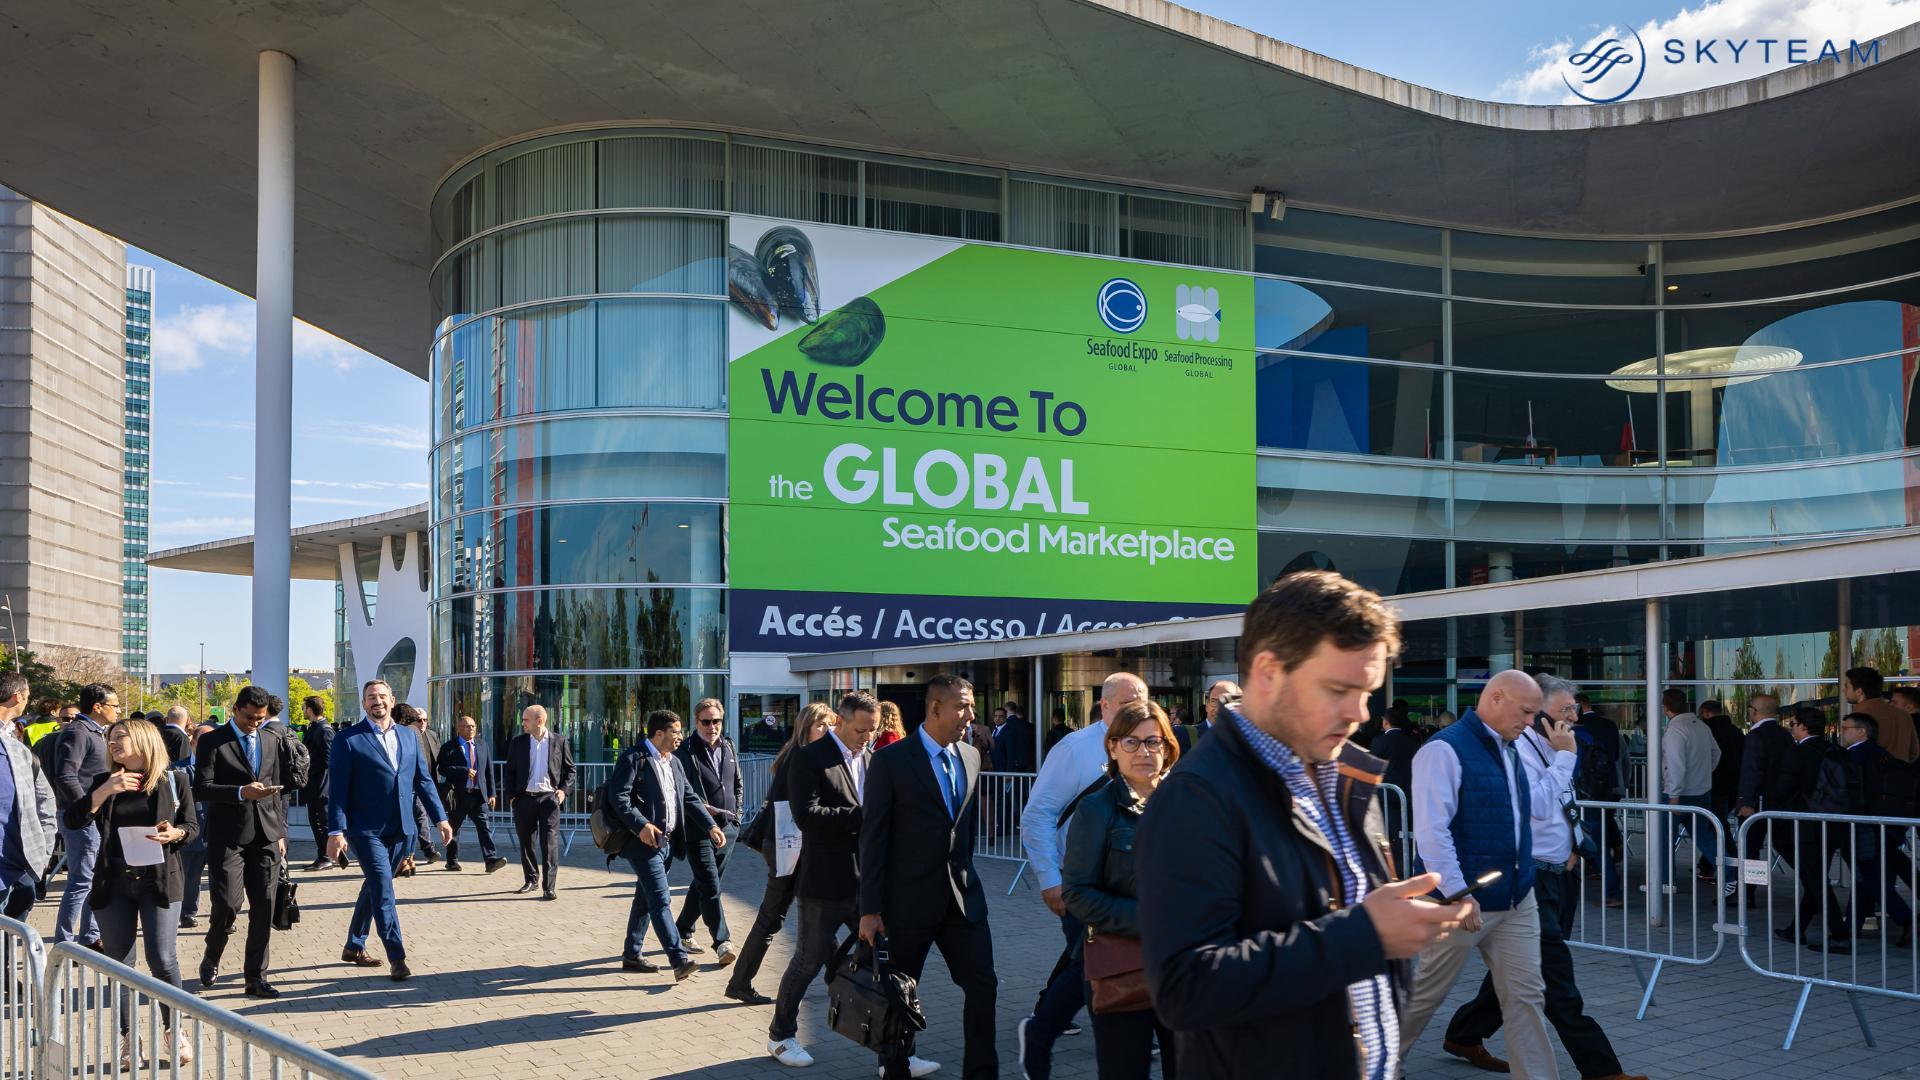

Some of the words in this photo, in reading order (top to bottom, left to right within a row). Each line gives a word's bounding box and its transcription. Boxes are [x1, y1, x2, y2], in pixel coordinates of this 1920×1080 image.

[1086, 338, 1130, 358] Seafood
[1132, 342, 1158, 364] Expo
[1164, 350, 1194, 364] Seafood
[1195, 352, 1233, 370] Processing
[1108, 363, 1137, 372] GLOBAL
[1184, 369, 1213, 378] GLOBAL
[761, 368, 1019, 432] Welcome
[1029, 390, 1087, 437] To
[768, 474, 813, 500] the
[823, 443, 1089, 515] GLOBAL
[882, 517, 1030, 553] Seafood
[1039, 523, 1235, 565] Marketplace
[758, 606, 863, 638] Accés
[894, 609, 1026, 640] Accesso
